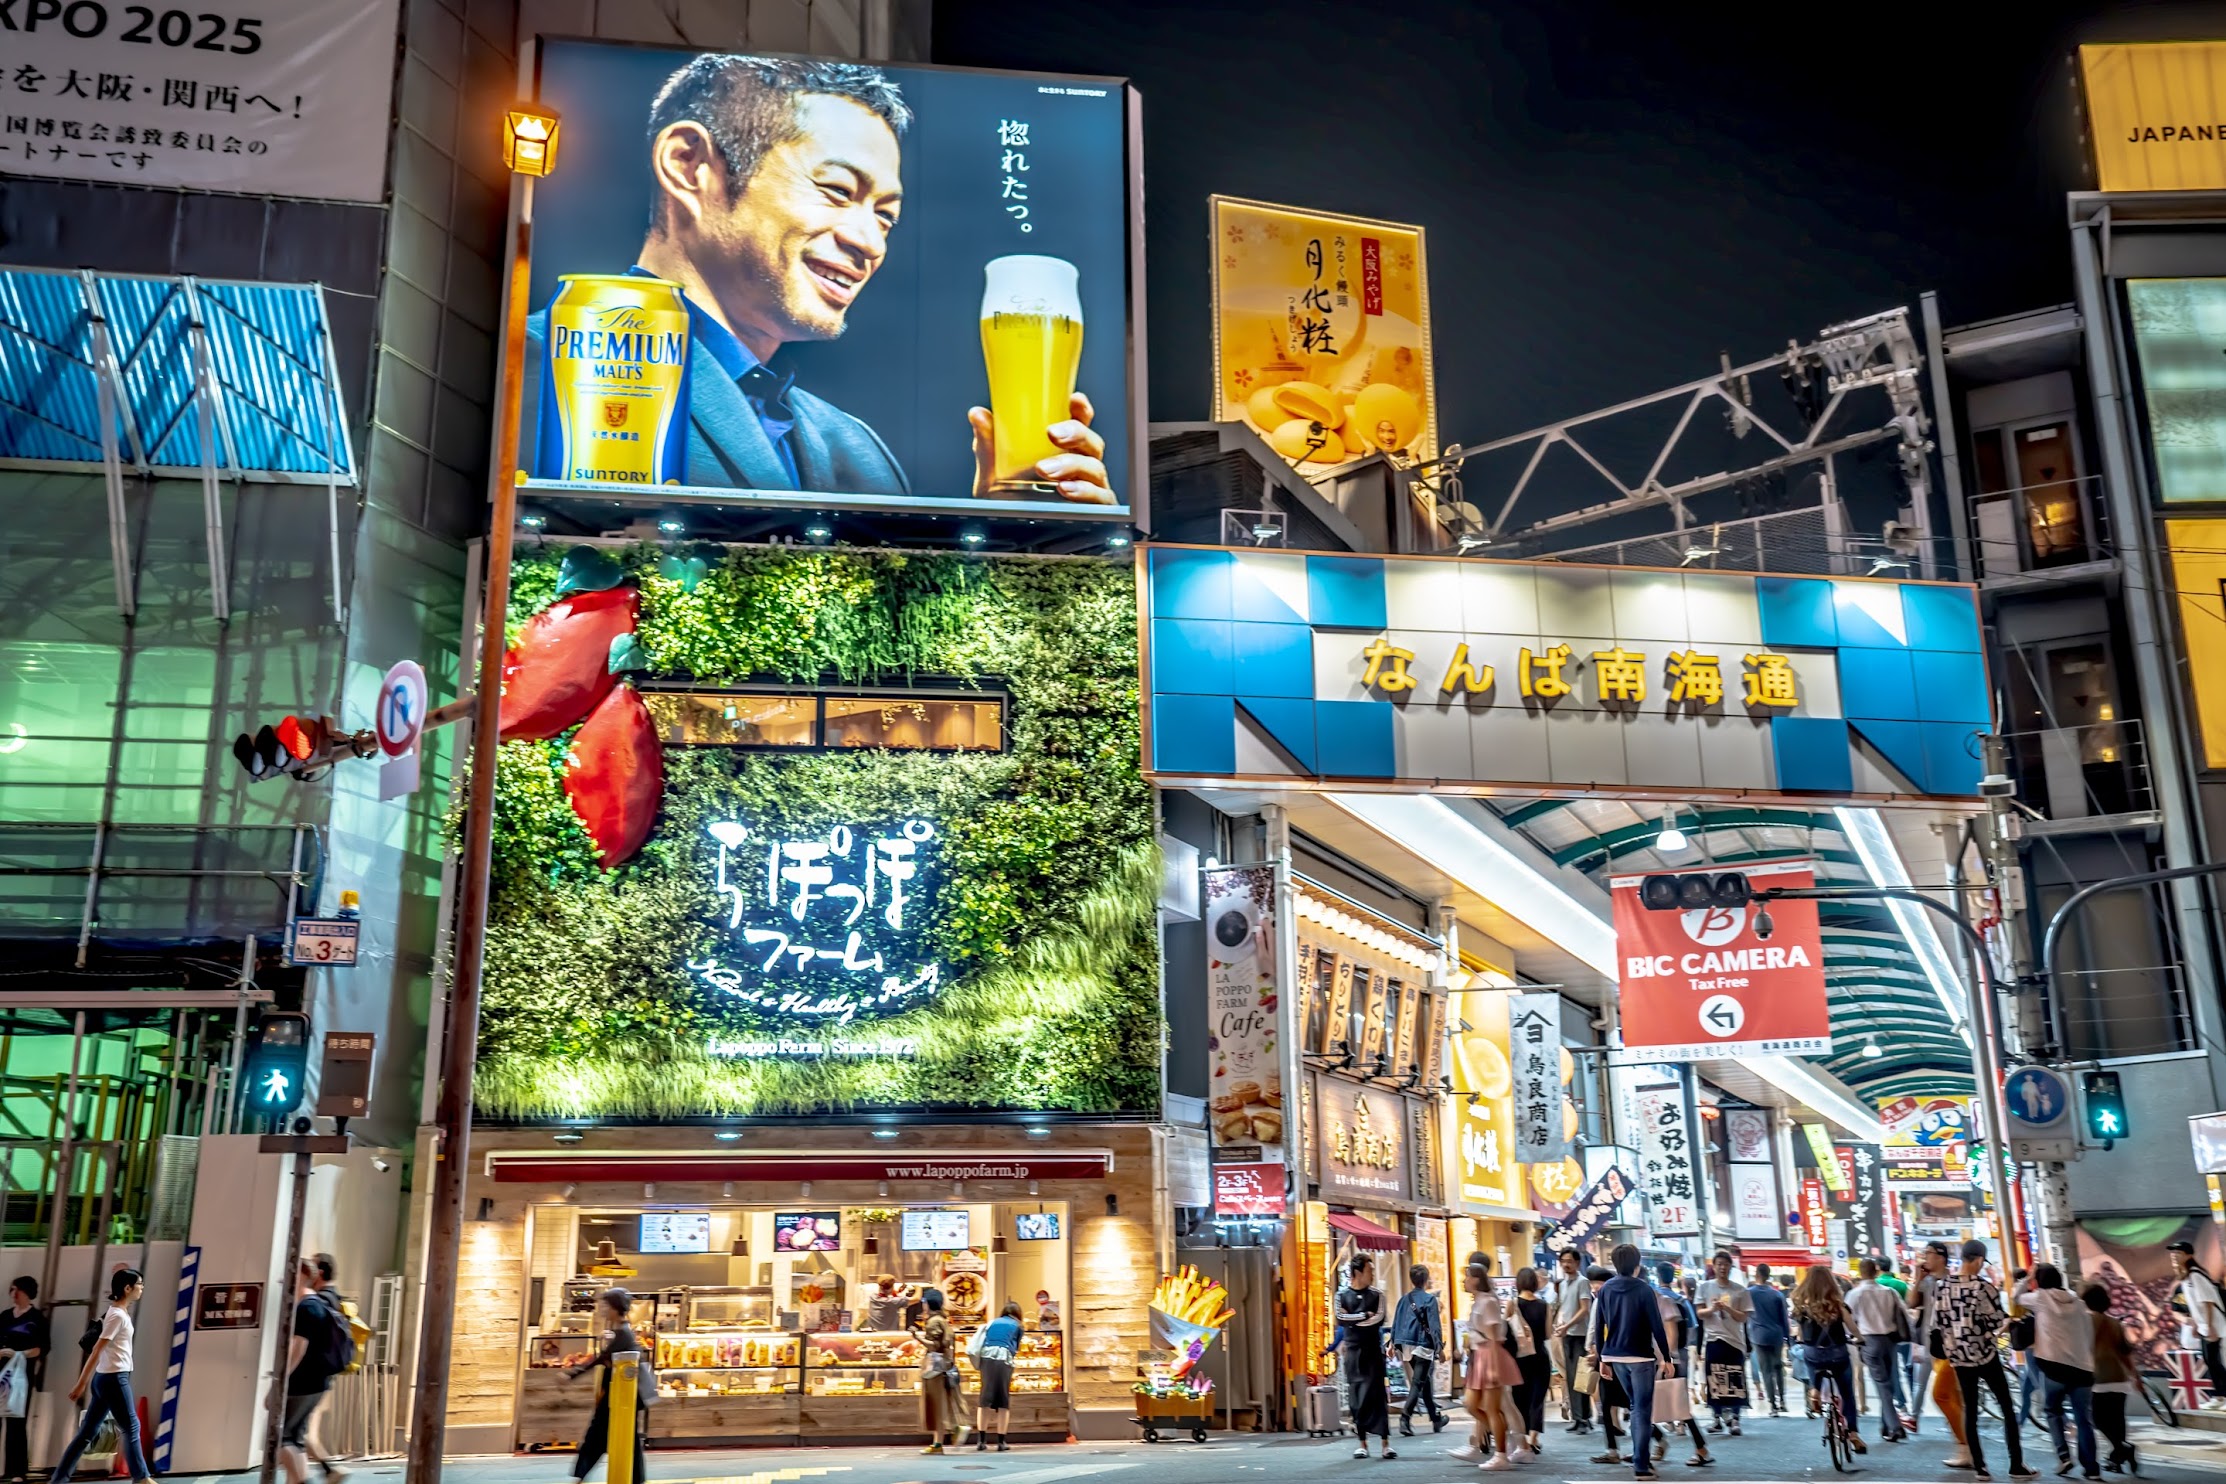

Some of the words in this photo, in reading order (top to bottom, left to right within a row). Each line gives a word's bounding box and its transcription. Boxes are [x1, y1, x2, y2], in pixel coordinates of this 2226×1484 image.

[120, 6, 262, 54] 2025
[0, 64, 302, 119] を大阪・関西へ!
[998, 119, 1032, 233] 惚れたっ。
[1365, 245, 1381, 309] 大阪みやげ
[584, 303, 655, 330] The
[553, 326, 684, 366] PREMIUM
[592, 363, 644, 380] MALT'S
[1363, 638, 1799, 706] なんば南海通
[317, 940, 331, 961] 3
[743, 929, 884, 973] ファーム
[1627, 954, 1676, 979] BIC
[1680, 945, 1812, 975] CAMERA
[1216, 973, 1231, 984] LA
[1216, 985, 1253, 997] POPPO
[1688, 979, 1716, 991] Tax
[1716, 977, 1750, 990] Free
[1216, 998, 1248, 1010] FARM
[1221, 1010, 1265, 1038] Cafe
[1526, 1053, 1549, 1147] 鳥良商店
[1659, 1102, 1692, 1199] お好み焼
[885, 1163, 1029, 1179] www.lapoppofarm.jp
[1661, 1206, 1688, 1223] 2F
